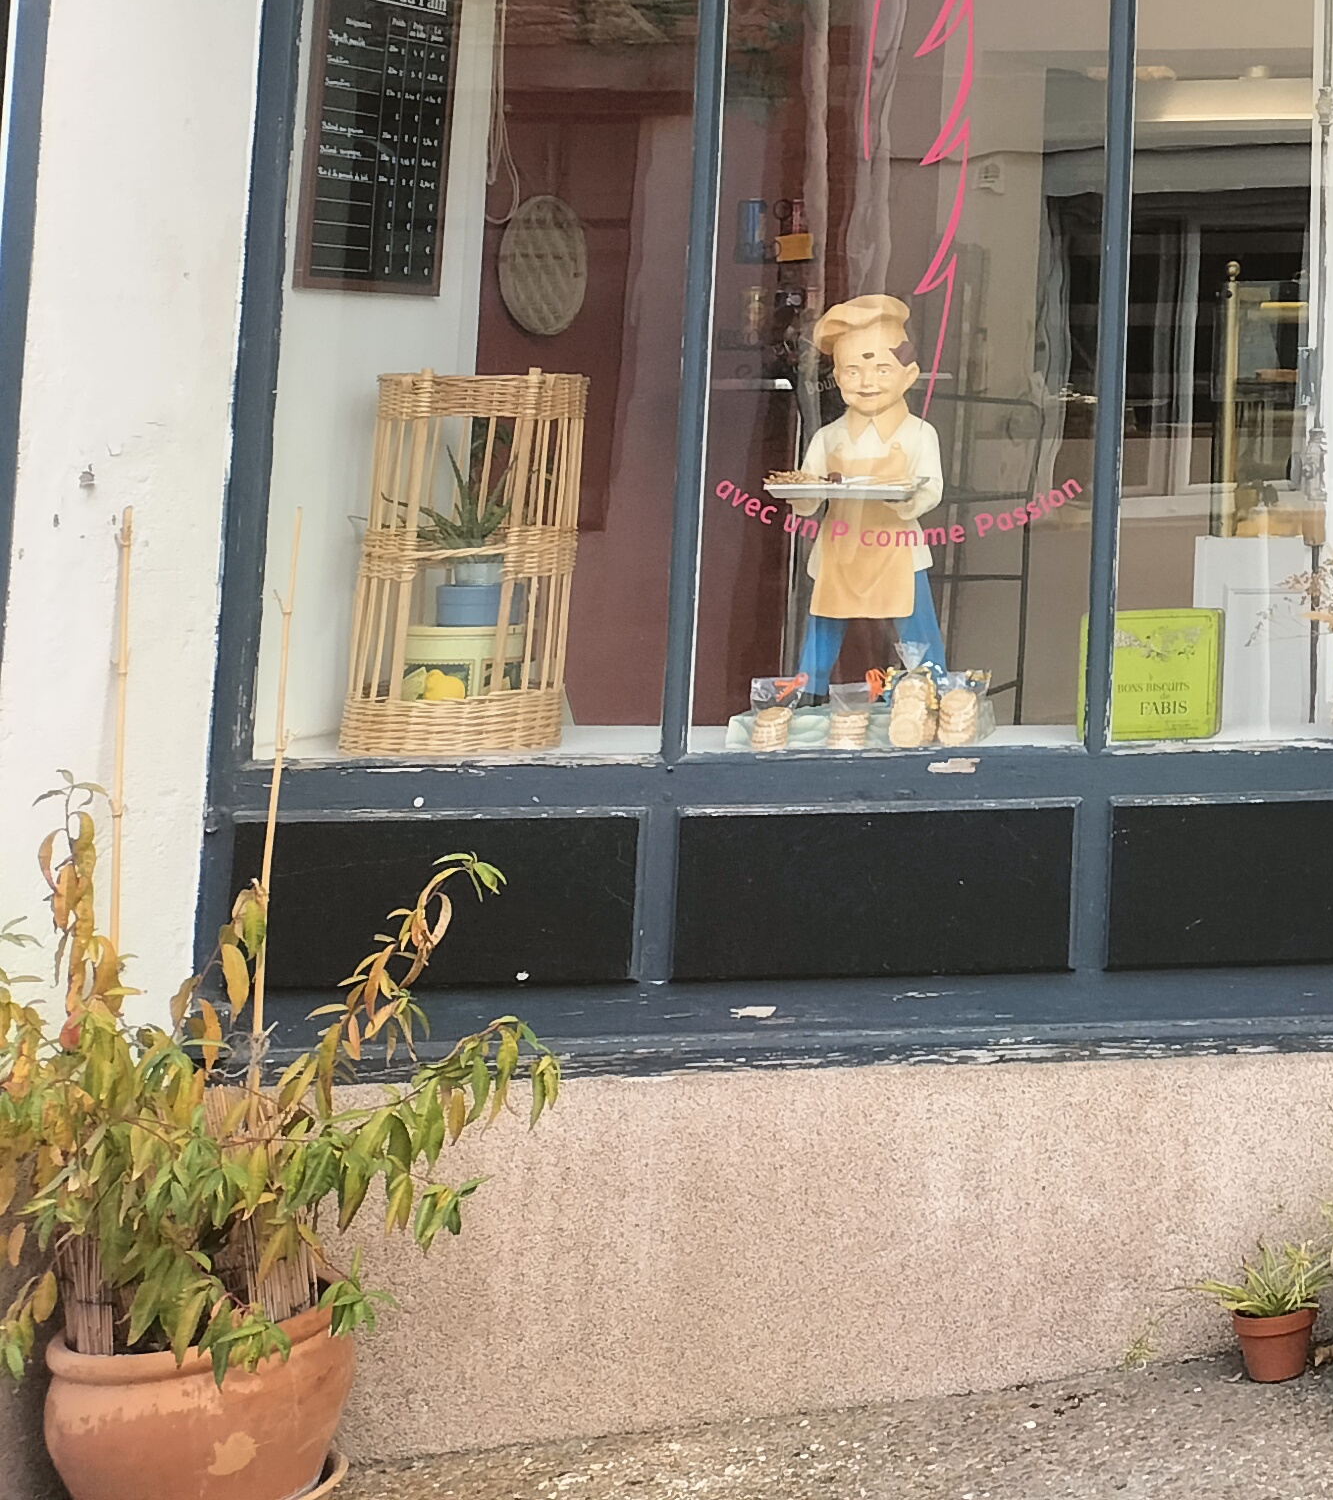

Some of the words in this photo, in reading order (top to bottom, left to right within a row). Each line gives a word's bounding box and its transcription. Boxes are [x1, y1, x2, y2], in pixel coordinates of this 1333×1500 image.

[715, 478, 777, 525] avec
[783, 513, 819, 541] un
[831, 520, 849, 542] P
[860, 523, 965, 548] comme
[975, 476, 1083, 538] Passion
